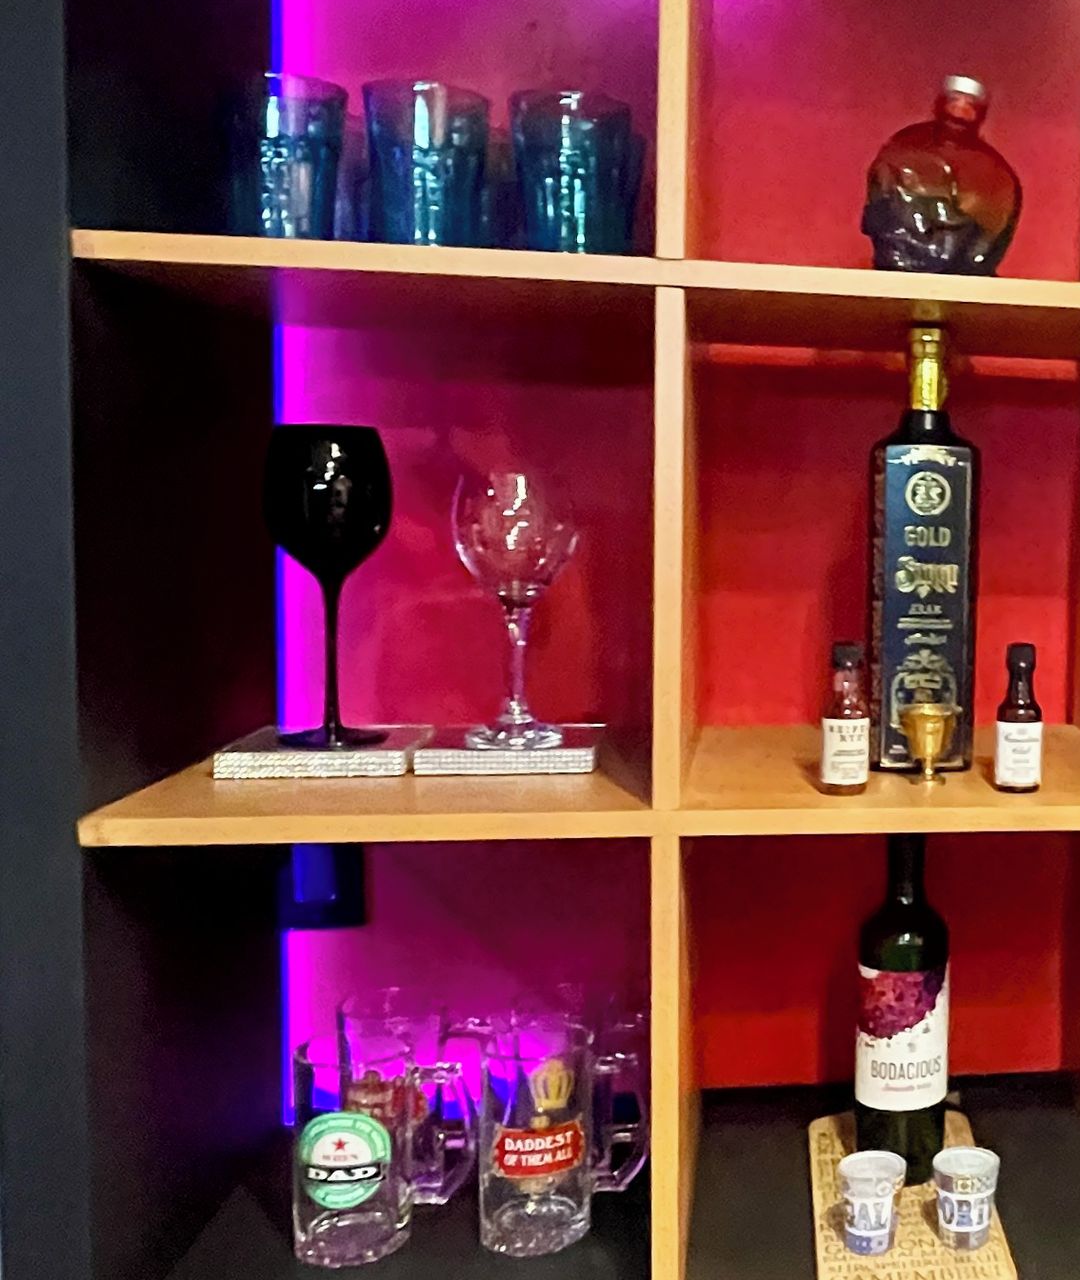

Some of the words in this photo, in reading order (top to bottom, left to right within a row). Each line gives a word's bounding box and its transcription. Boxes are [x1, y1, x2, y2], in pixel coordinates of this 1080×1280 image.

[904, 525, 951, 548] GOLD
[871, 1057, 942, 1081] BODACIOUS
[504, 1131, 574, 1151] DADDEST
[503, 1153, 519, 1167] OF
[521, 1152, 553, 1167] THEM
[555, 1146, 573, 1162] ALL
[308, 1166, 377, 1181] DAD
